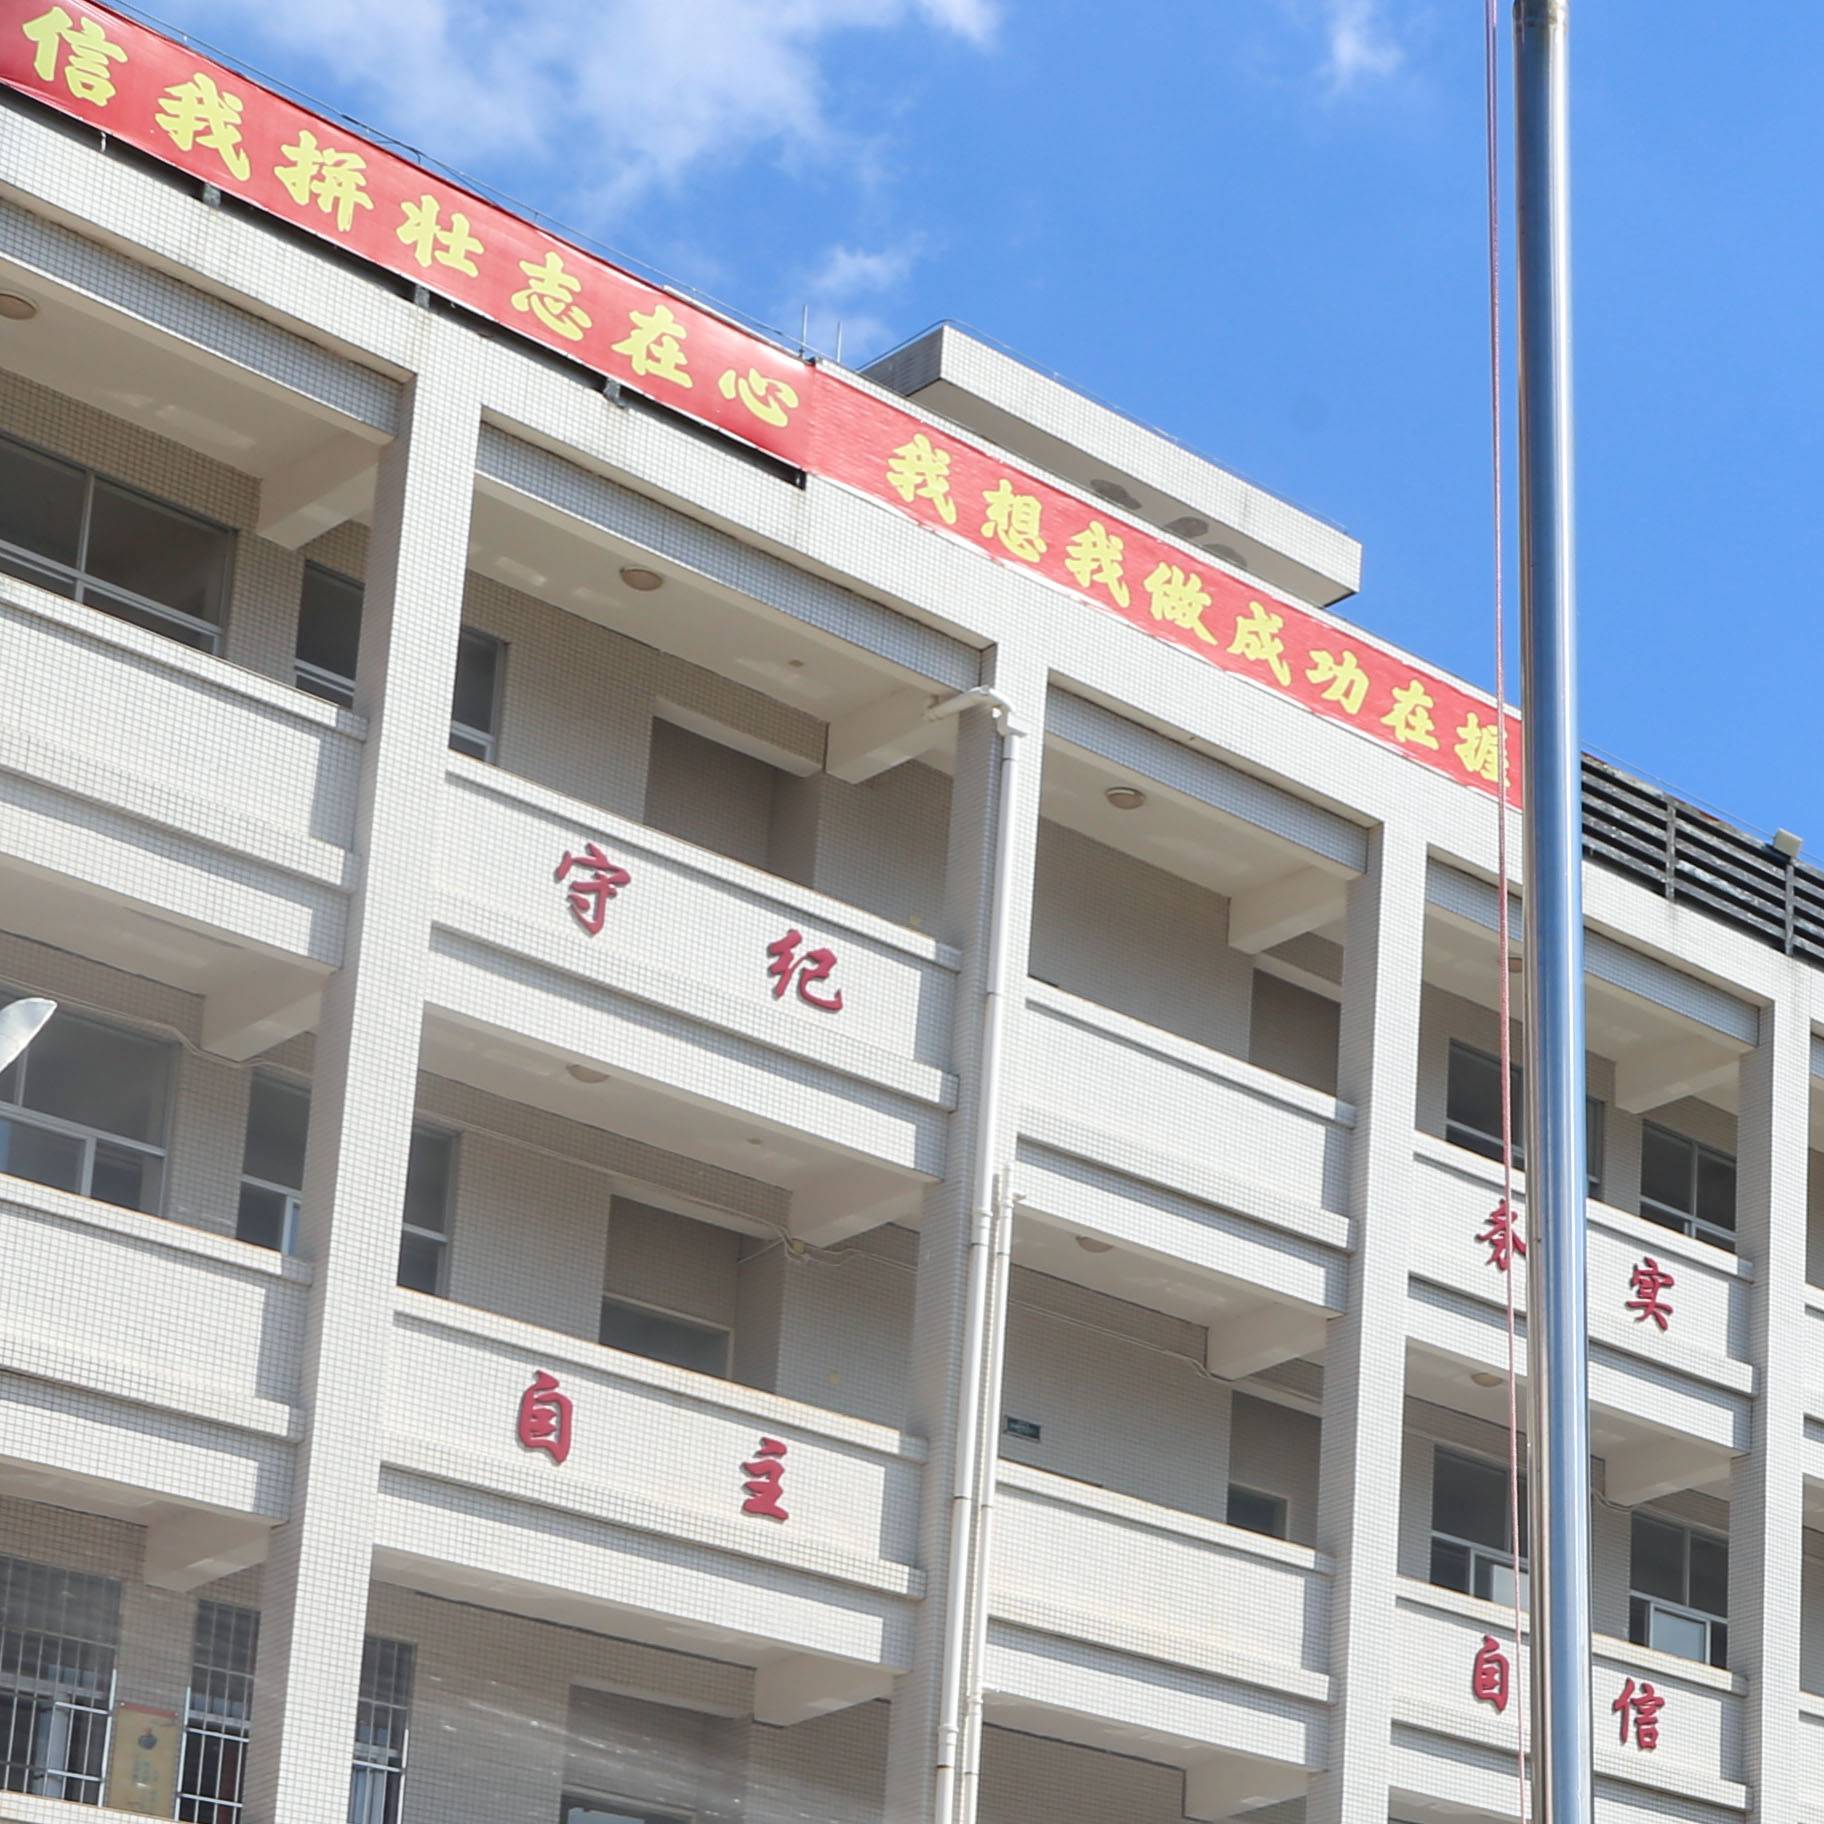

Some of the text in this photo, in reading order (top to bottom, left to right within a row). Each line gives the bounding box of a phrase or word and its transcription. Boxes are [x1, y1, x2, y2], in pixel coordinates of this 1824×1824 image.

[886, 434, 1511, 787] 我想我做成功在握
[555, 842, 842, 1013] 守纪
[518, 1369, 789, 1523] 自主
[1471, 1636, 1666, 1751] 自信
